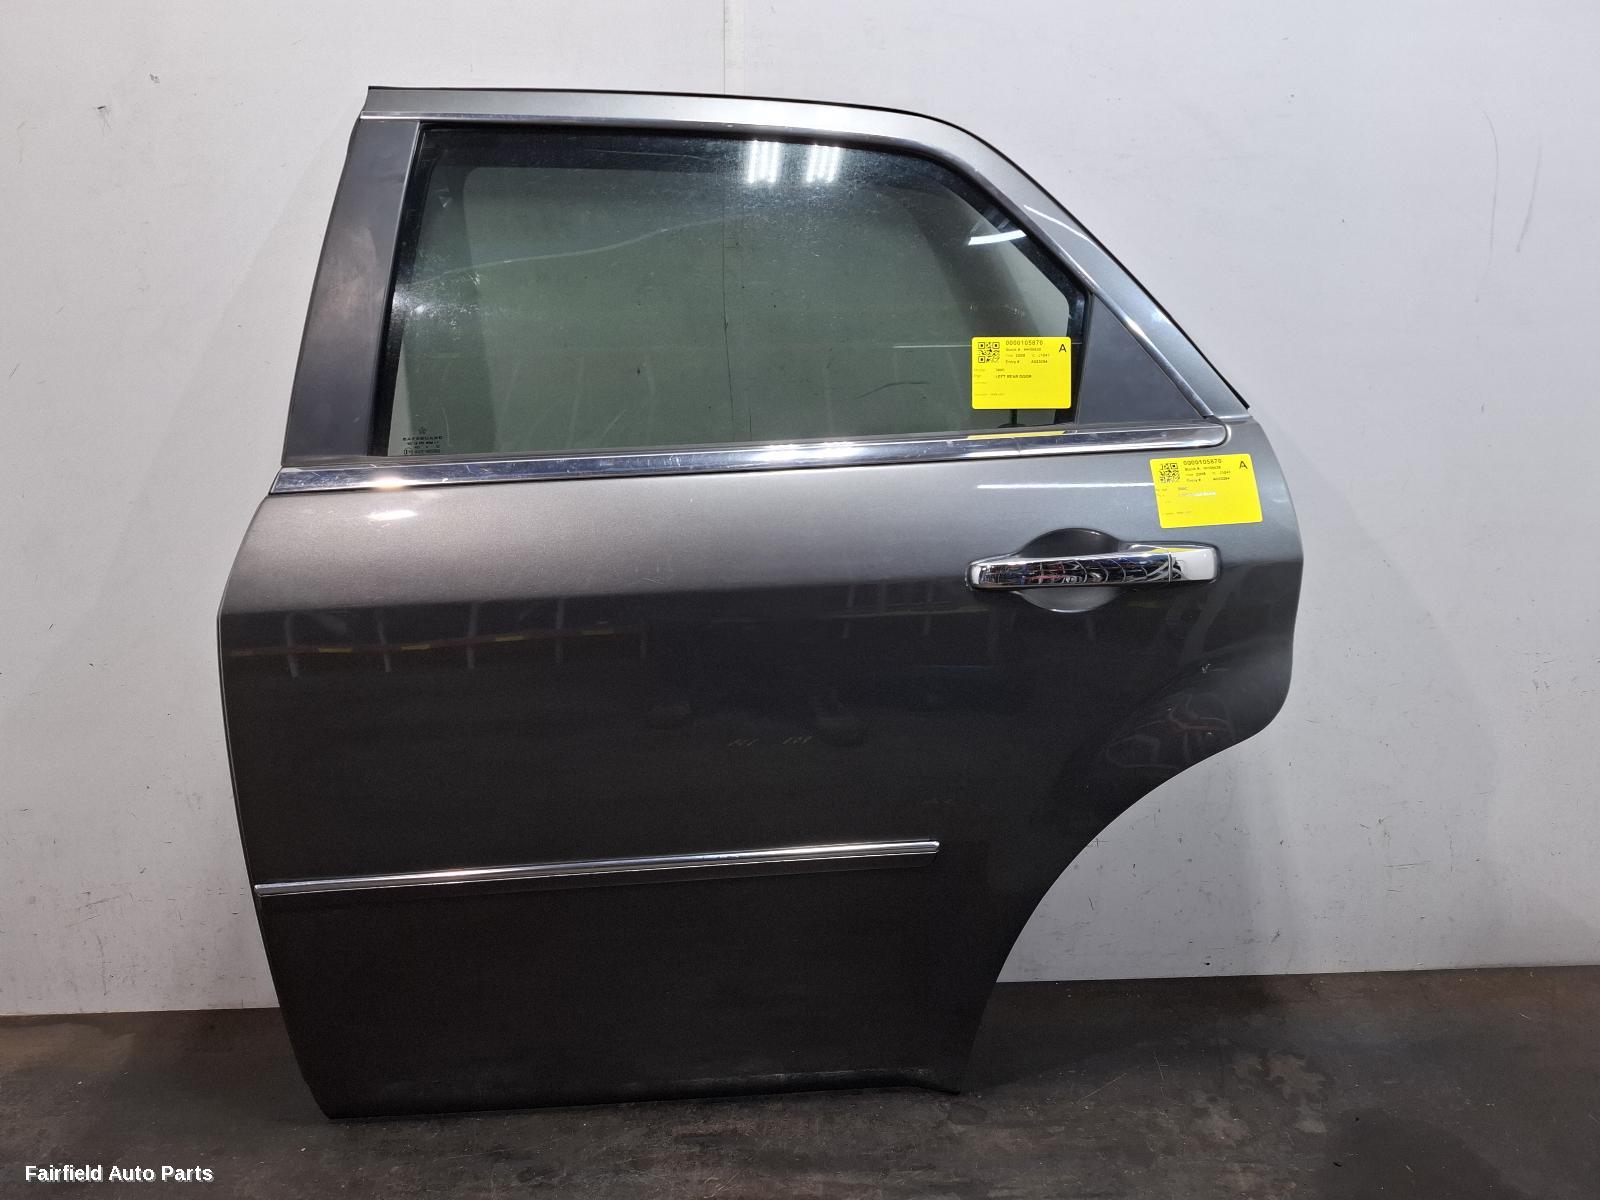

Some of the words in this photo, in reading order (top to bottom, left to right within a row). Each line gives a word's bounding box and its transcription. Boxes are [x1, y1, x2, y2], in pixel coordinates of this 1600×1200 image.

[1058, 343, 1067, 353] A
[1182, 458, 1222, 466] 0000105870
[1239, 460, 1248, 470] A
